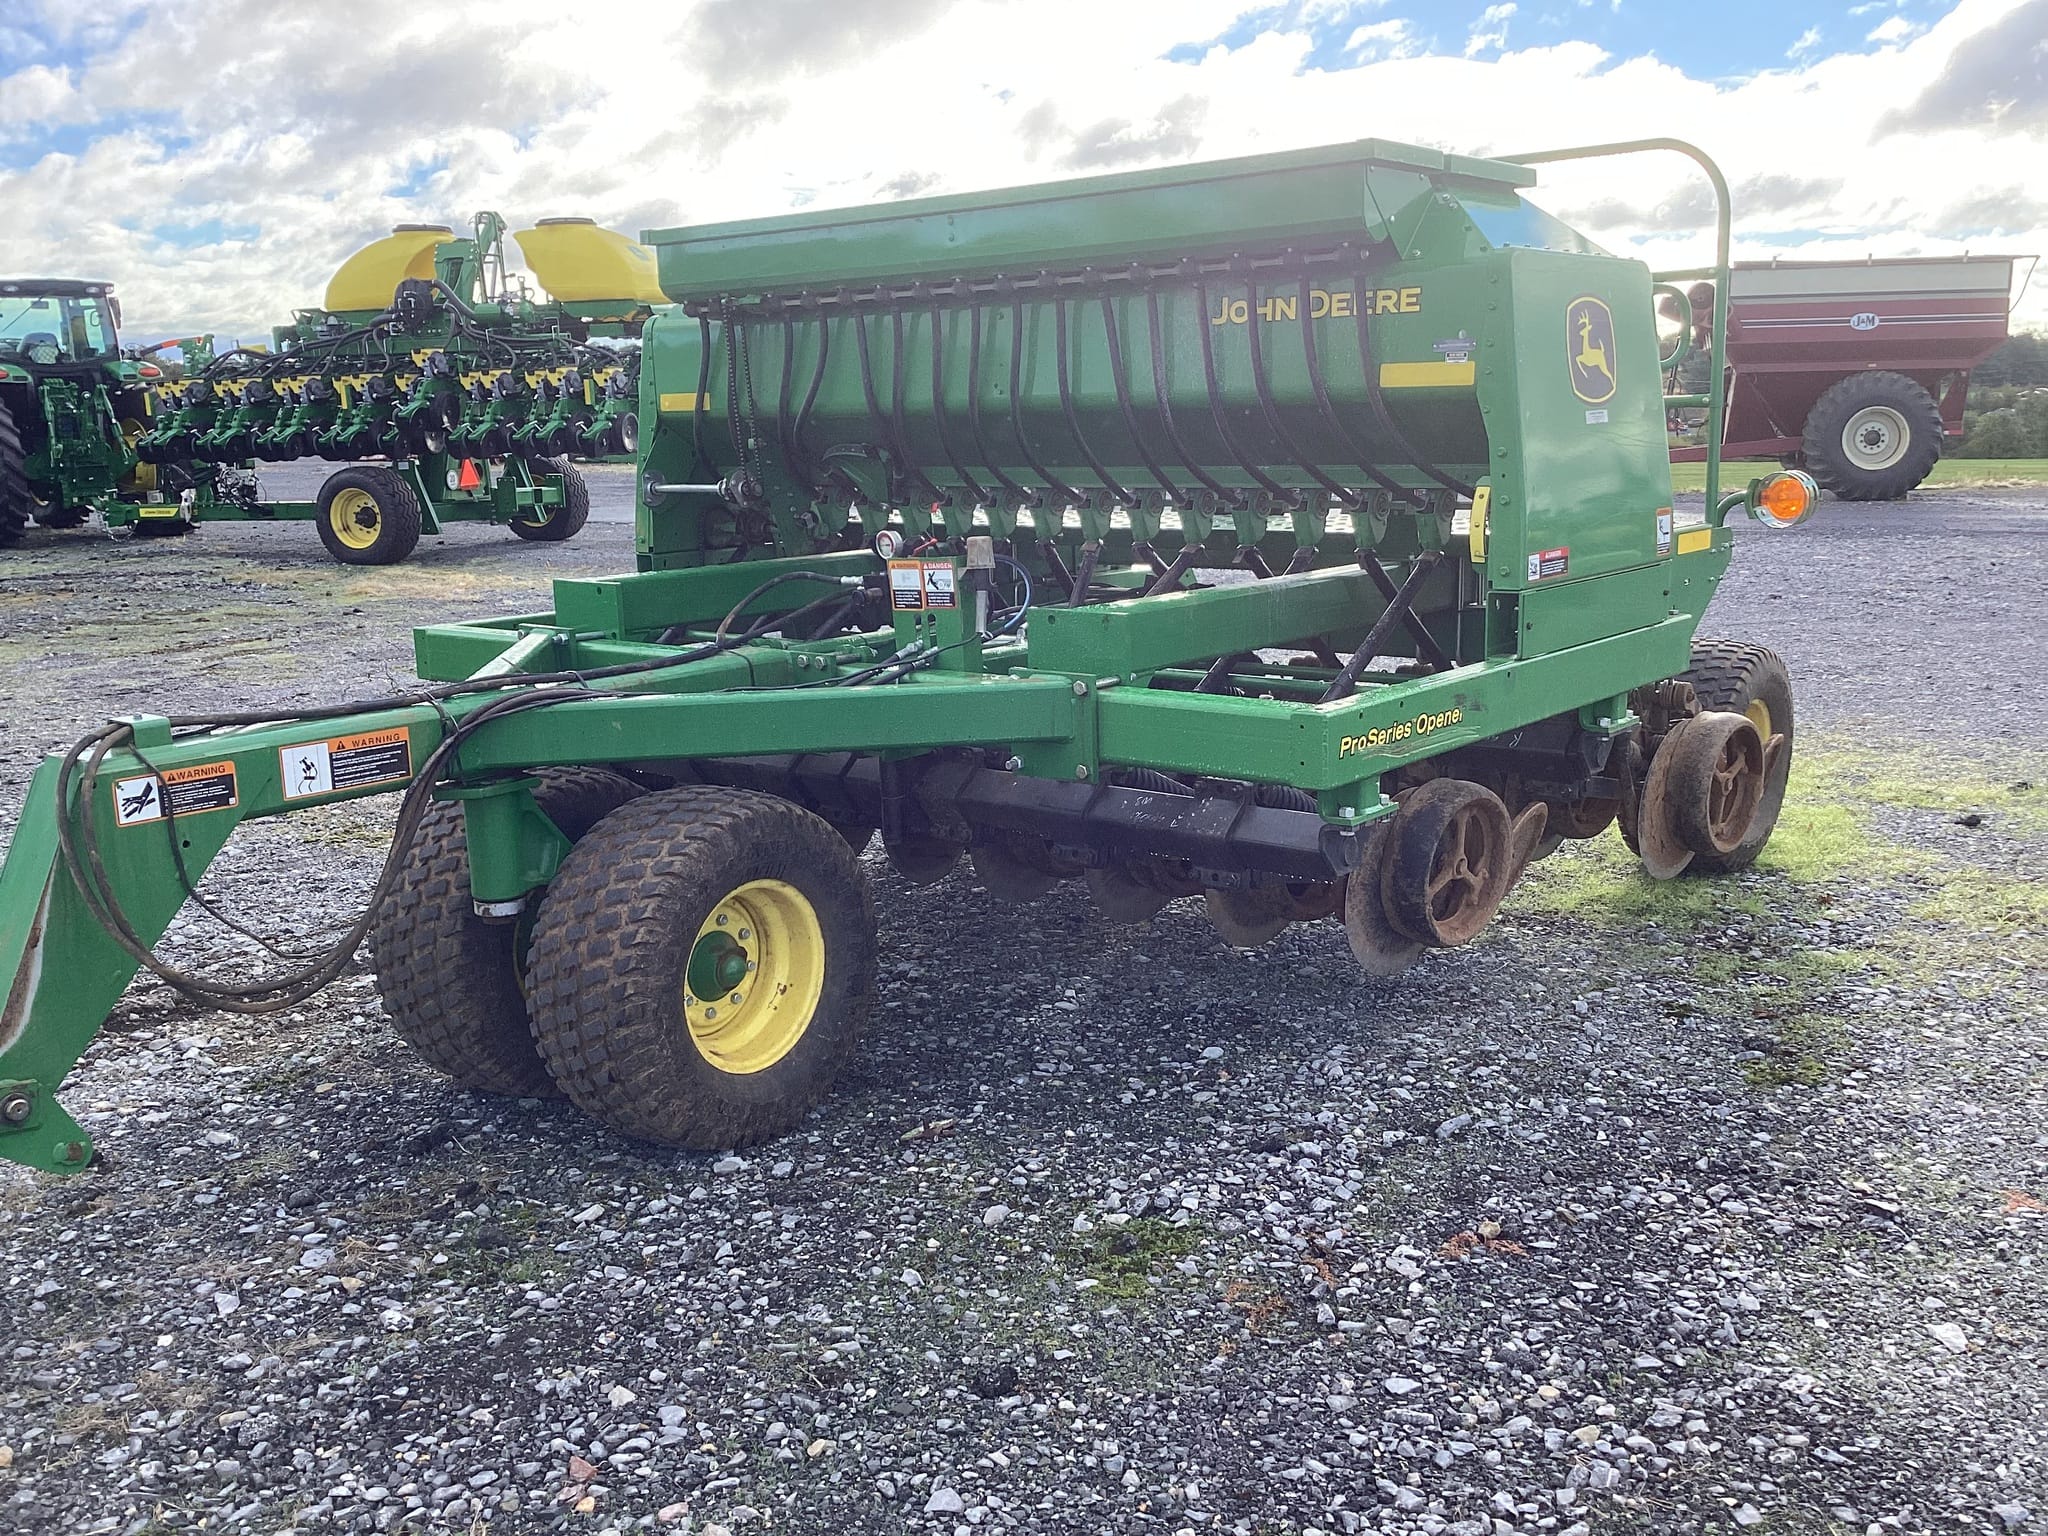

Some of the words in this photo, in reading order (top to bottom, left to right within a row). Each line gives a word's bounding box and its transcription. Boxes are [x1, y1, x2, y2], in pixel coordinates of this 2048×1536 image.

[1211, 295, 1297, 326] JOHN
[352, 733, 400, 748] WARNING
[1338, 720, 1412, 759] ProSeries
[176, 764, 226, 781] WARNING
